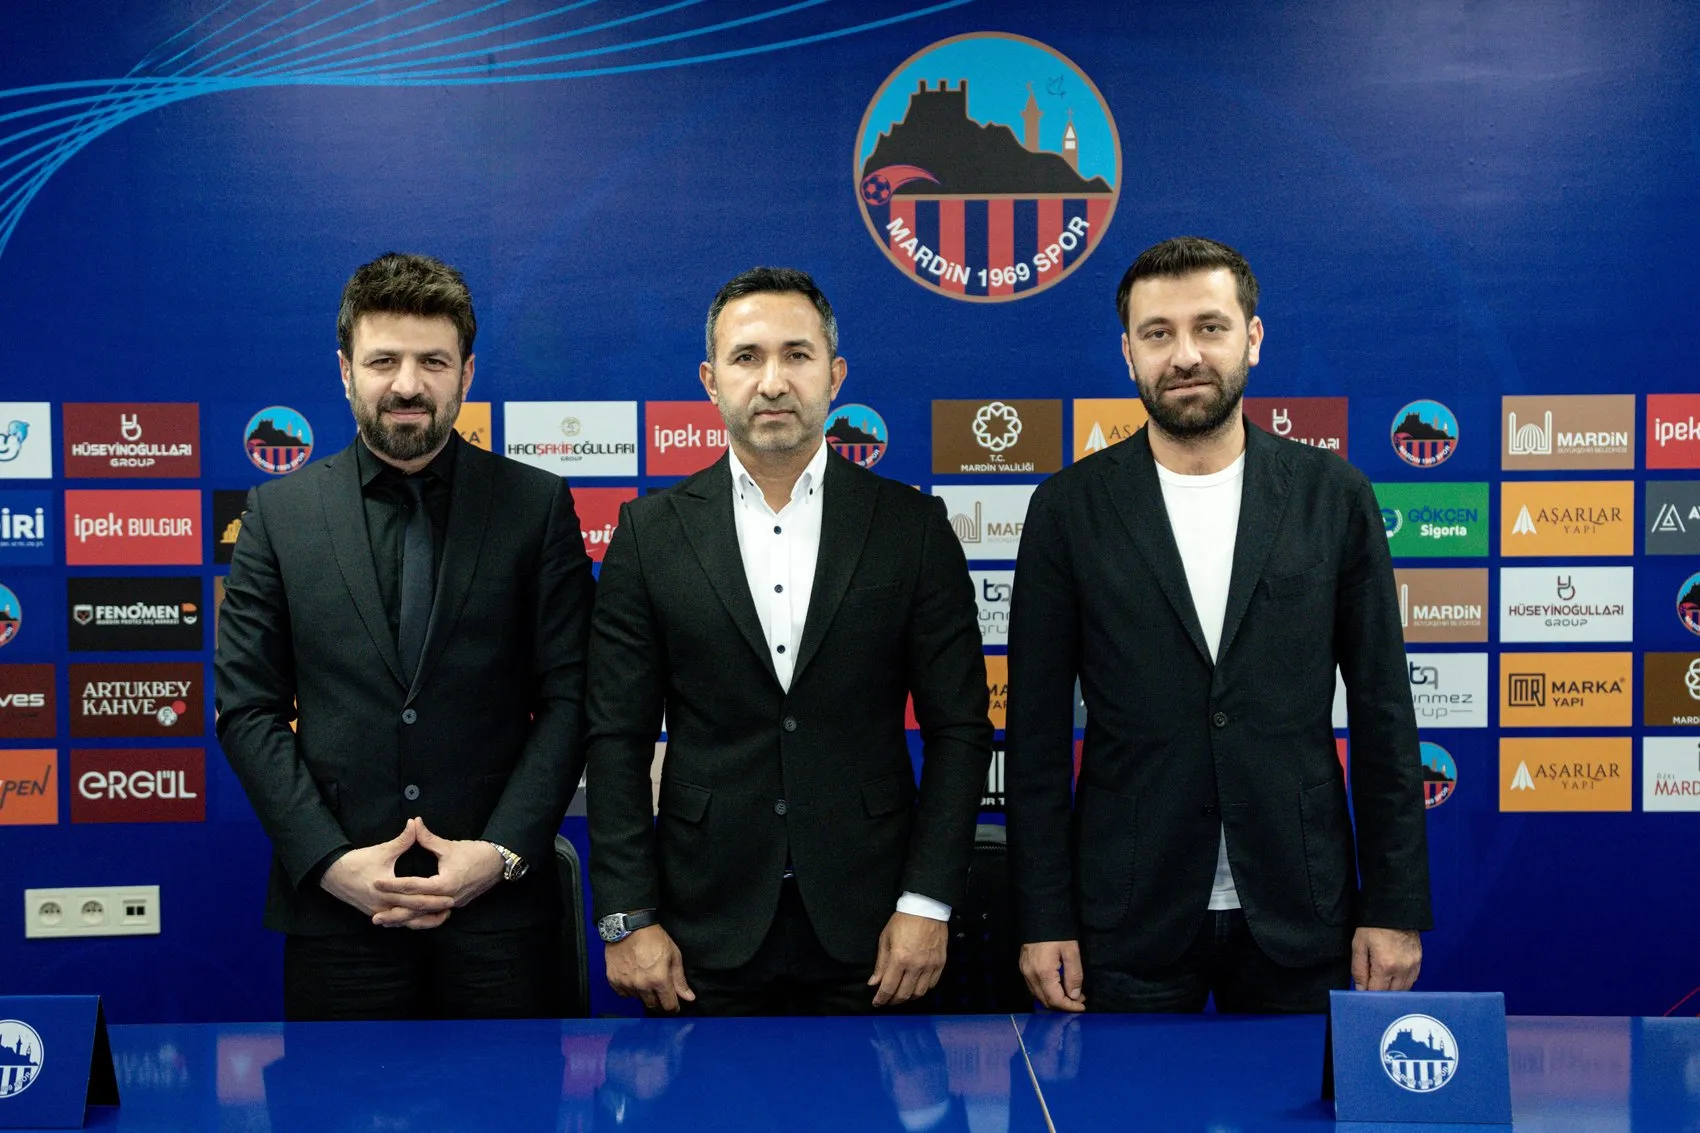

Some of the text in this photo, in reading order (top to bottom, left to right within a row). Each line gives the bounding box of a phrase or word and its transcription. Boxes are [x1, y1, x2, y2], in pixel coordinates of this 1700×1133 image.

[978, 262, 1030, 287] 1969
[1032, 215, 1091, 273] SPOR
[654, 424, 730, 453] ipek BU
[1655, 416, 1700, 447] ipek
[72, 442, 192, 456] HÜSEYİNOĞULLARI
[110, 458, 155, 467] GROUP
[989, 454, 1006, 462] T.C.
[961, 463, 996, 472] MARDİN
[1408, 505, 1478, 525] GÖKÇEN
[1536, 507, 1623, 525] AŞARLAR
[74, 512, 192, 543] ipek BULGUR
[1420, 523, 1468, 539] Sigorta
[1563, 525, 1596, 534] YAPI
[1509, 603, 1624, 616] HÜSEYİNOĞULLARI
[1545, 619, 1588, 627] GROUP
[83, 681, 191, 698] ARTUKBEY
[83, 699, 157, 716] KAHVE
[1552, 697, 1584, 707] YAPI
[1535, 762, 1620, 781] AŞARLAR
[1561, 781, 1595, 789] YAPI
